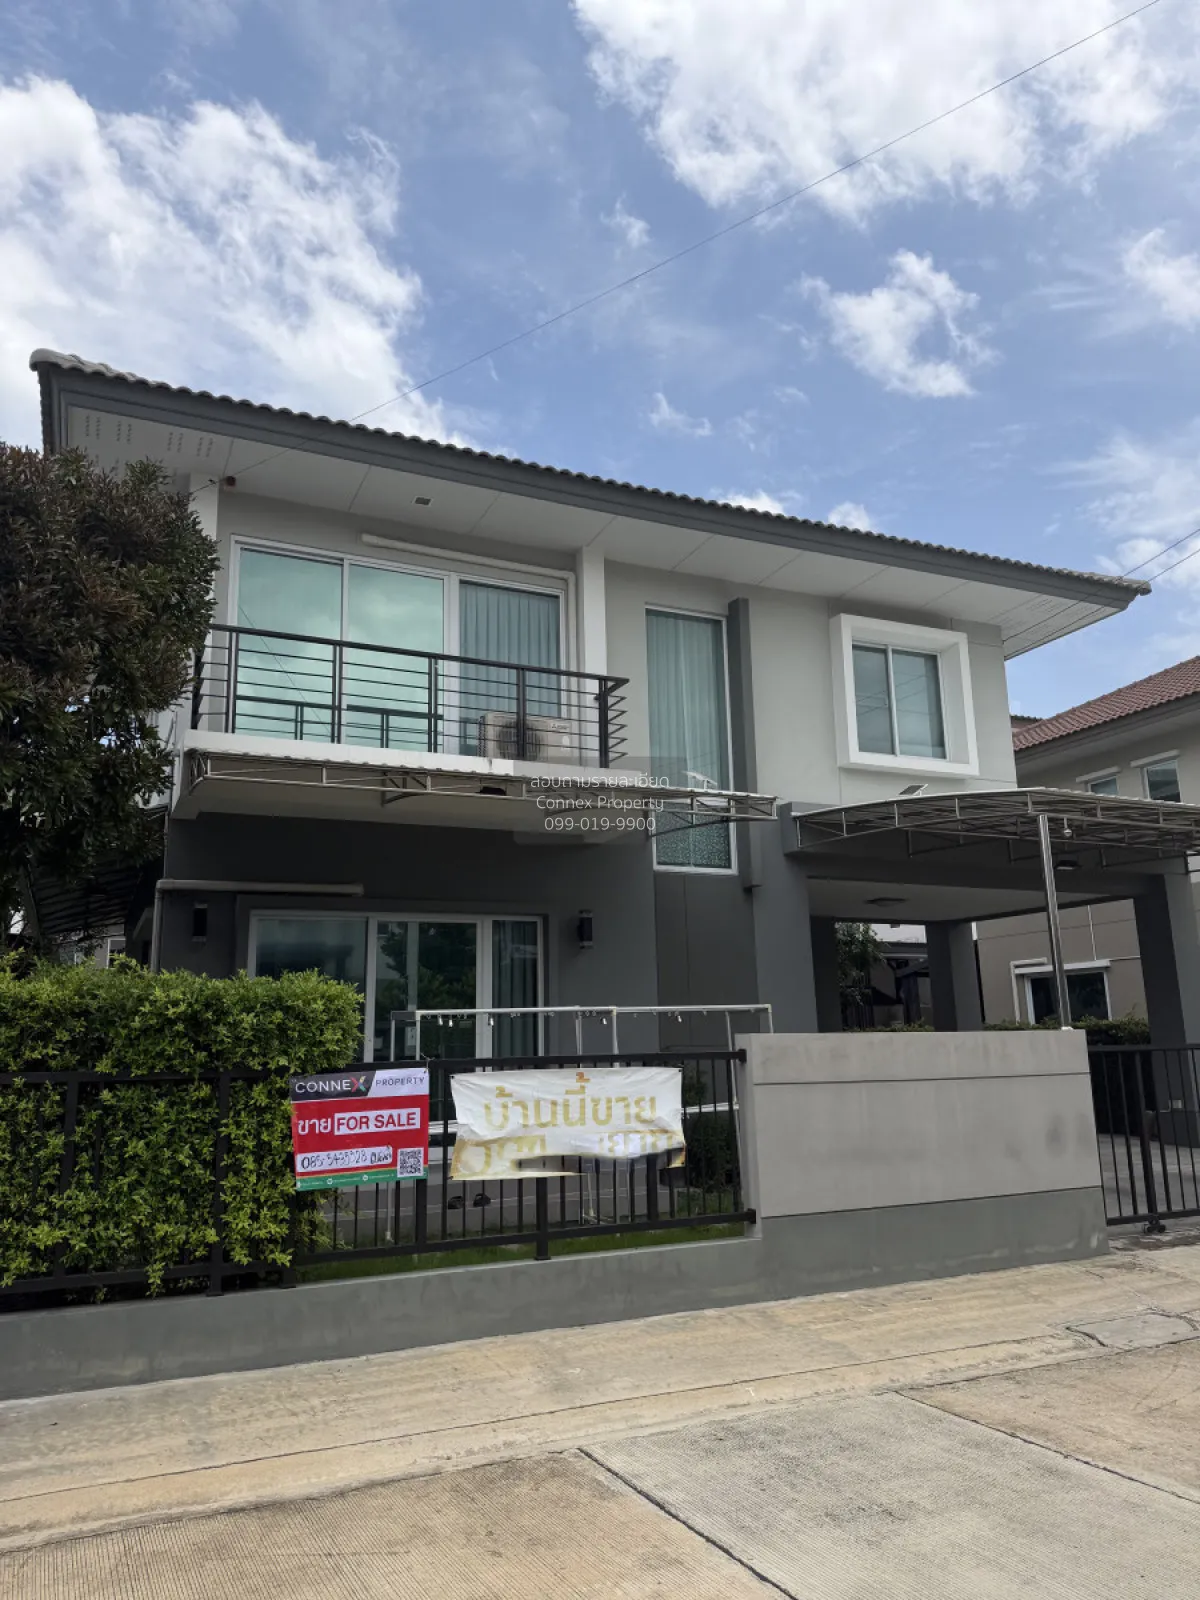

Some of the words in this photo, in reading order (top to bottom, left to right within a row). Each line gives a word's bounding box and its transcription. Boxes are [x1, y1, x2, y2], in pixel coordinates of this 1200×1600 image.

[295, 1076, 367, 1093] CONNEX
[375, 1076, 425, 1087] PROPERTY
[484, 1071, 657, 1131] บ้านนี้ขาย
[298, 1117, 332, 1136] ขาย
[336, 1115, 370, 1132] FOR
[374, 1111, 417, 1129] SALE
